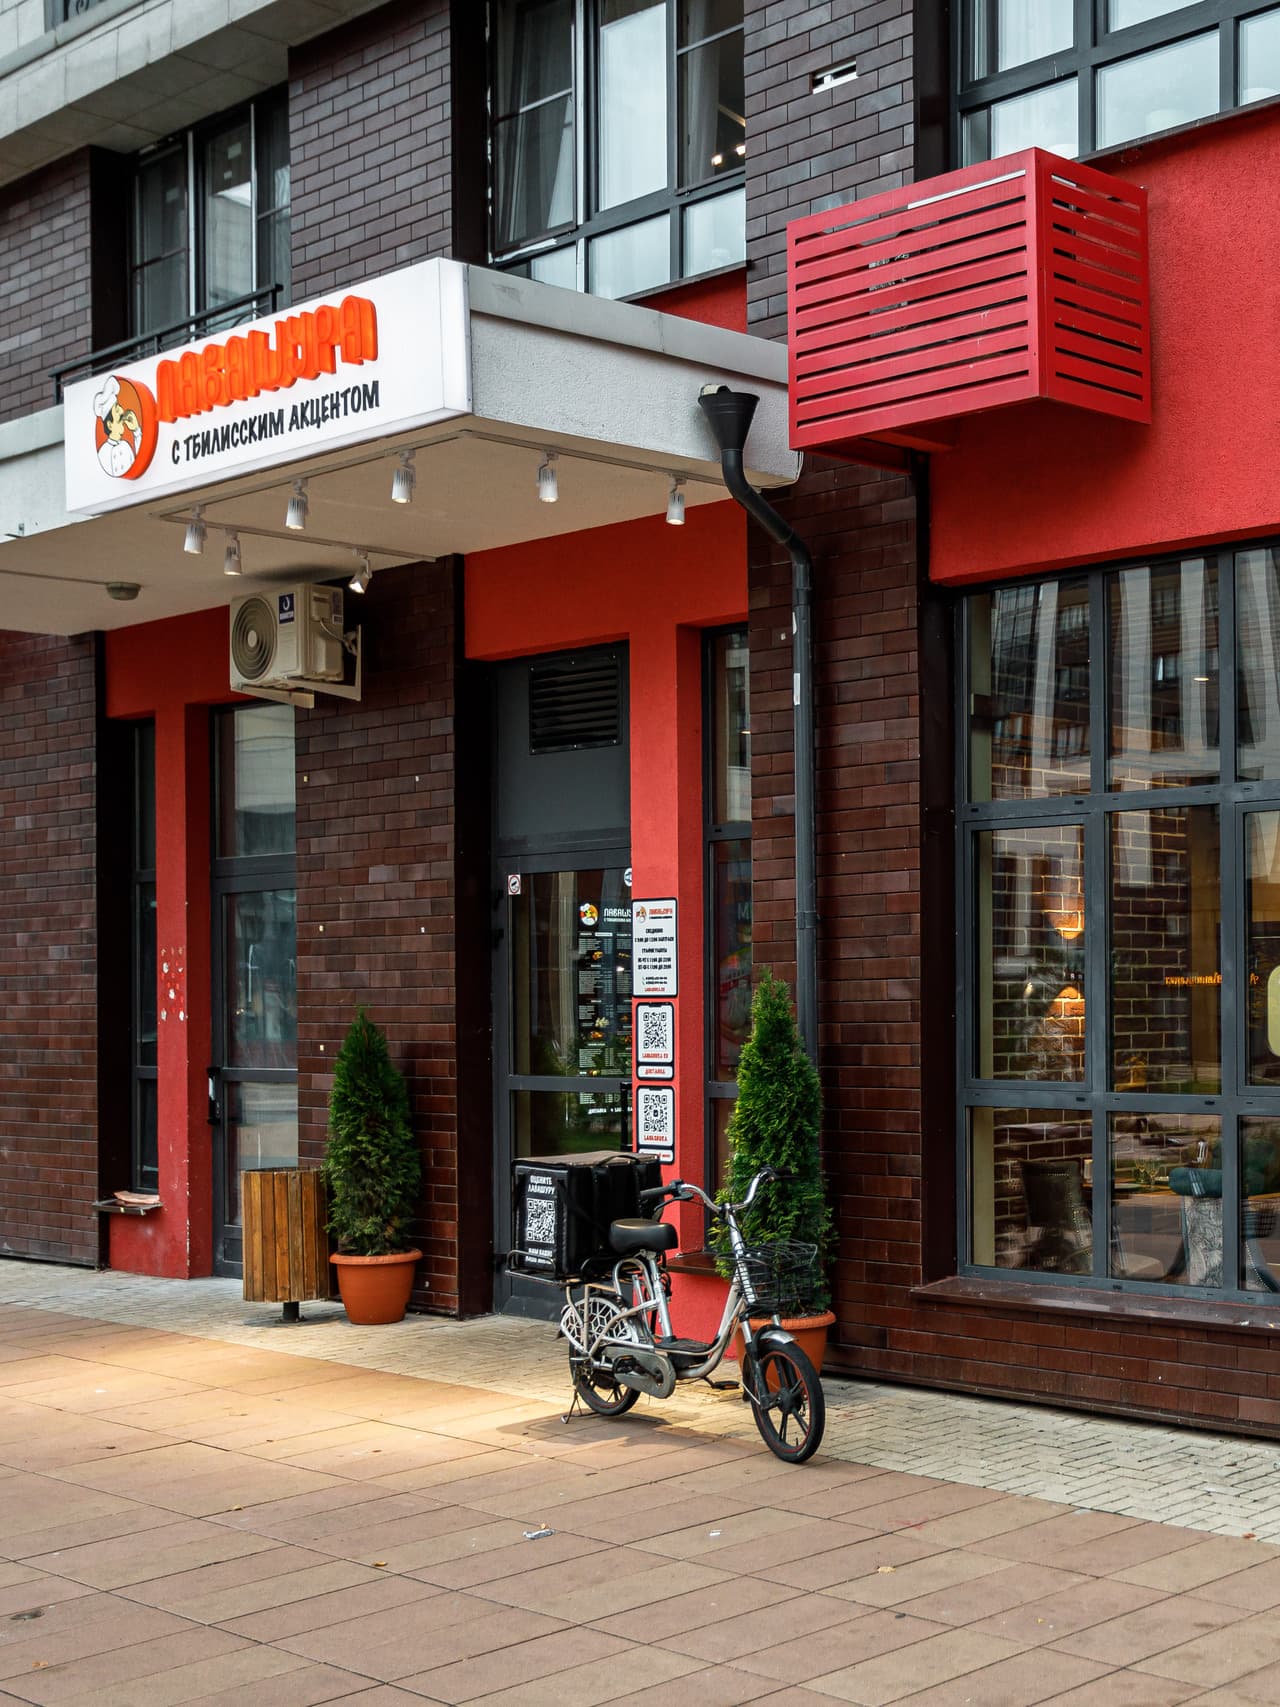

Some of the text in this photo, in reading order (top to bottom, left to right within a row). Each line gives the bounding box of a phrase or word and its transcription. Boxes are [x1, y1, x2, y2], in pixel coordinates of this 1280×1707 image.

[172, 380, 380, 465] С ТБИЛИССКИМ АКЦЕНТОМ
